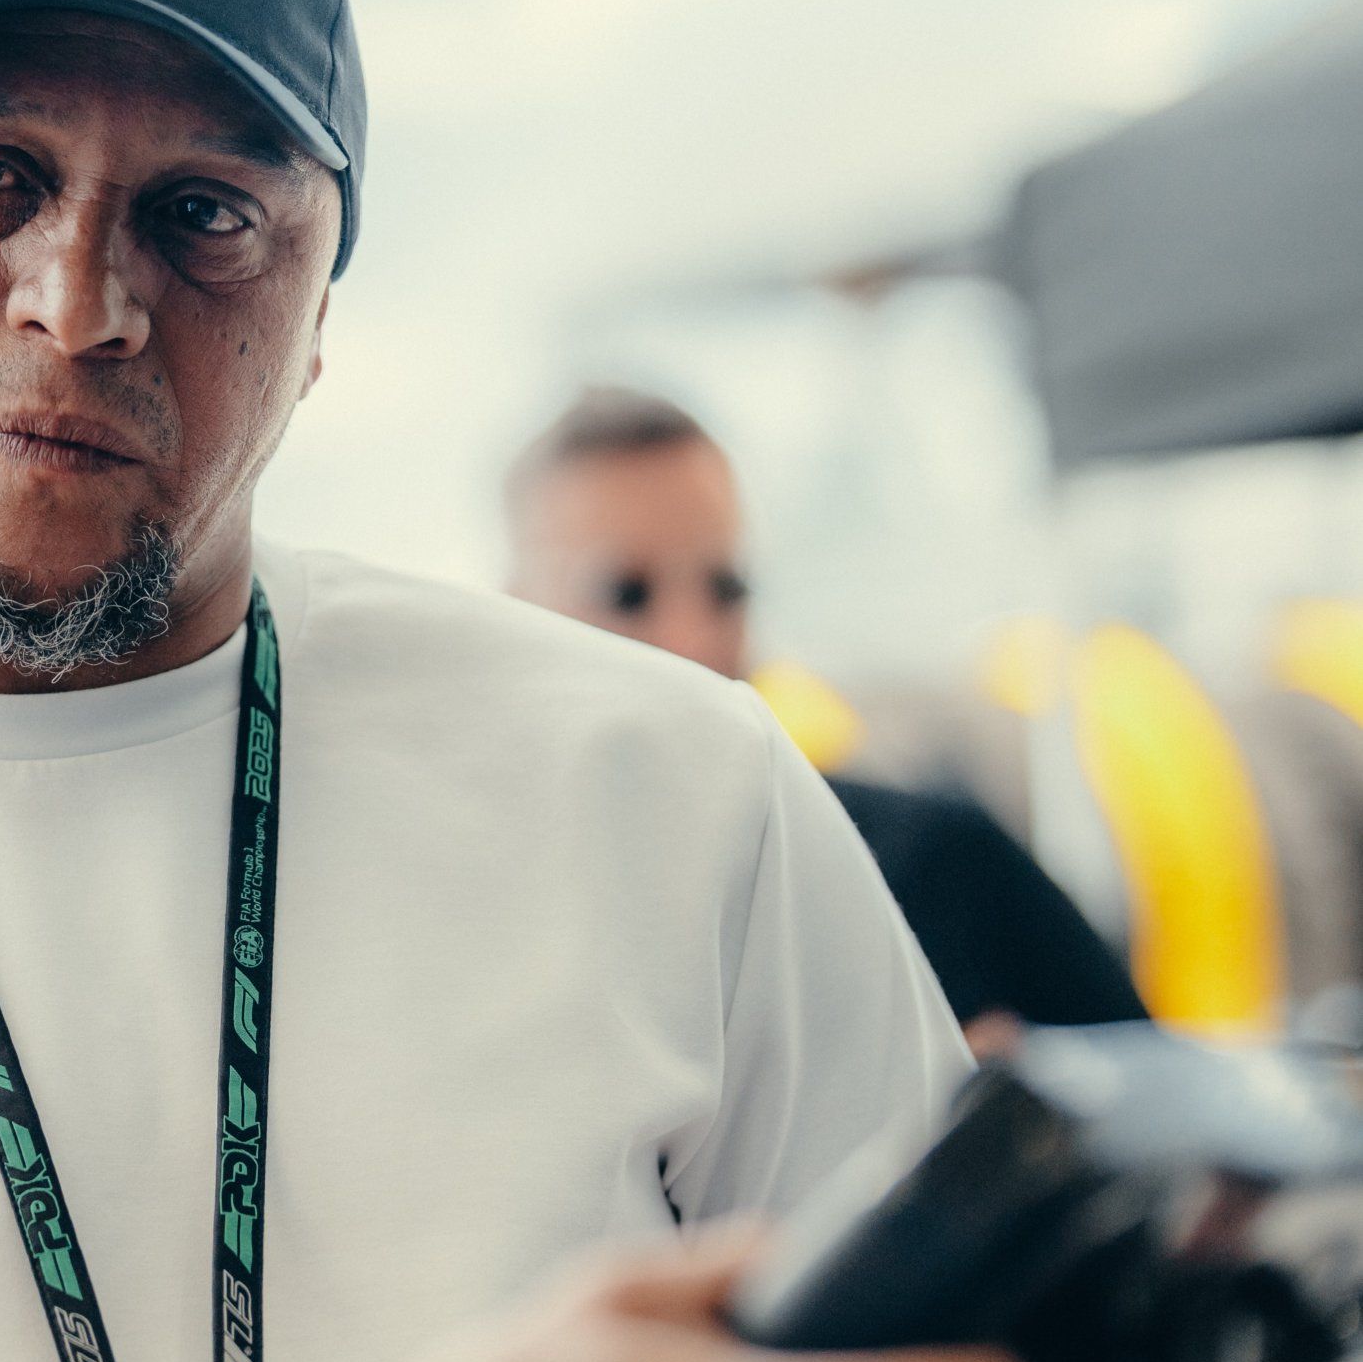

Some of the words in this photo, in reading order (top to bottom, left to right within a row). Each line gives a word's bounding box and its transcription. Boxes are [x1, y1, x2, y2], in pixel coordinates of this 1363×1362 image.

[244, 706, 274, 804] 2025
[240, 854, 254, 901] Formula
[240, 901, 251, 922] FIA
[251, 888, 262, 924] World
[233, 966, 260, 1054] F1
